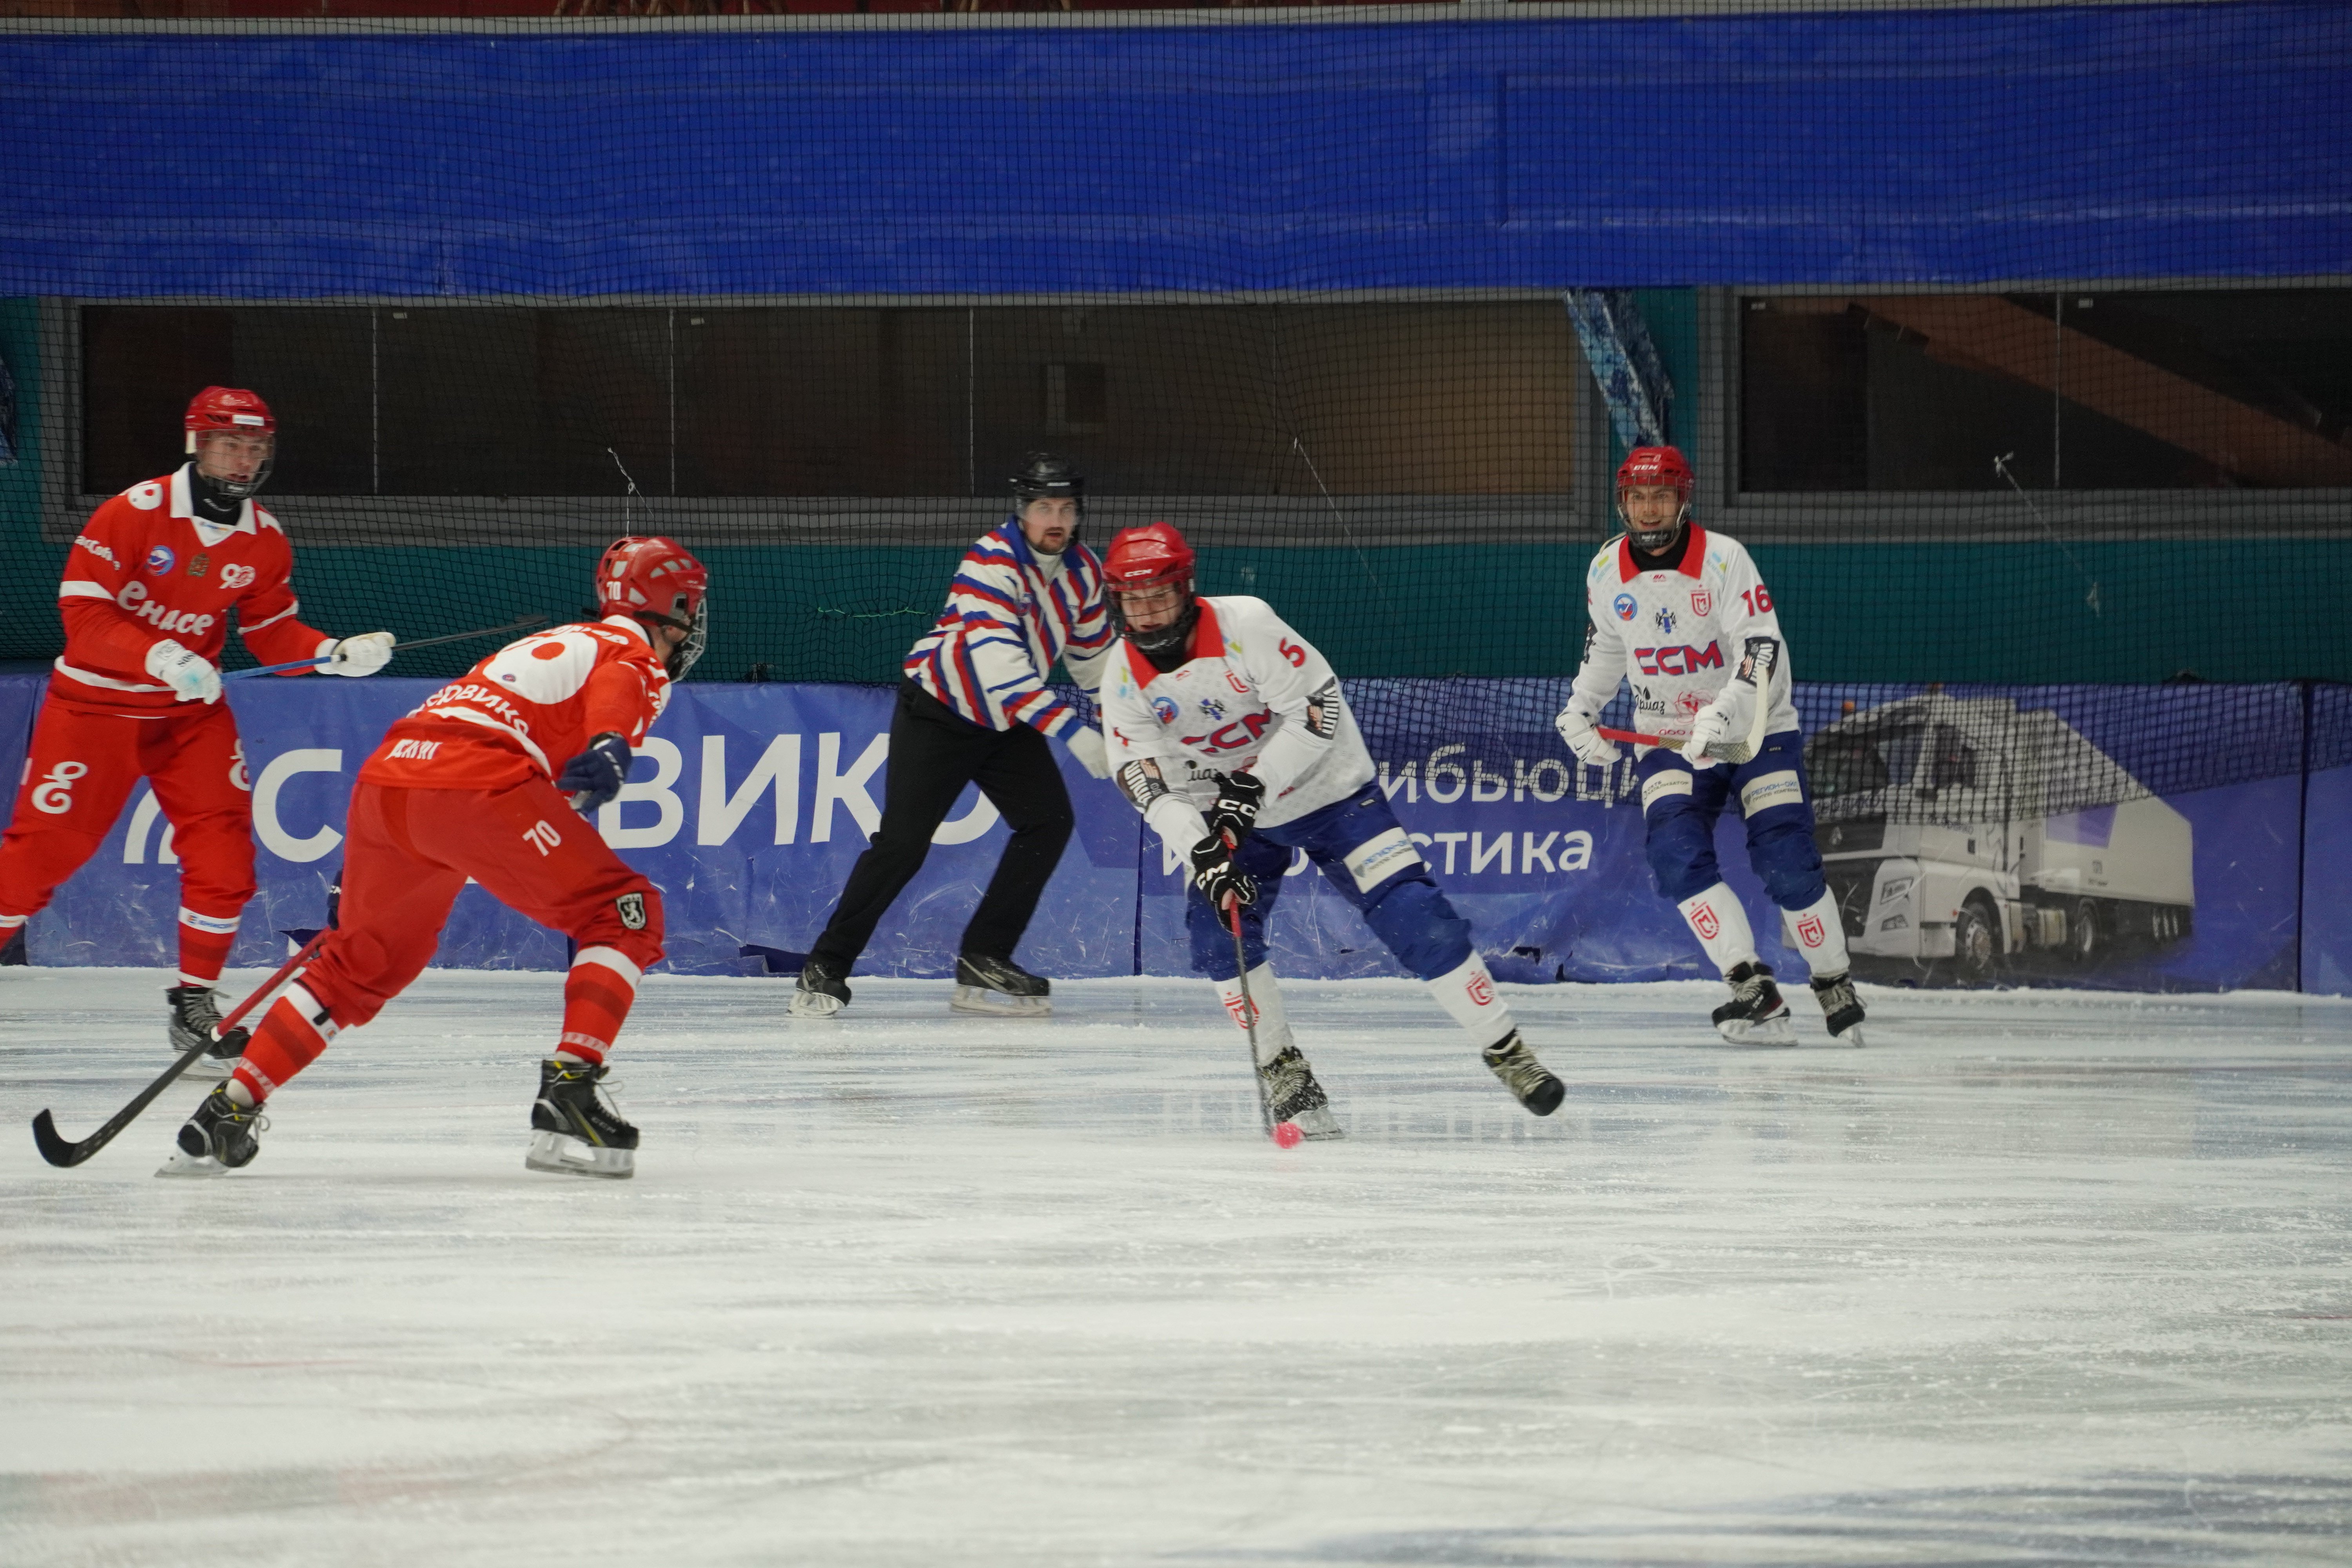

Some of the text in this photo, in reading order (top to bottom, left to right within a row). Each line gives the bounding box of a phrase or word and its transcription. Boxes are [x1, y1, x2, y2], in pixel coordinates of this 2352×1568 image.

[1124, 568, 1153, 577] CCM
[606, 581, 621, 600] 70
[1740, 584, 1774, 617] 16
[1279, 637, 1305, 668] 5
[1218, 799, 1259, 819] CC
[523, 820, 561, 857] 70
[1197, 861, 1230, 890] CM
